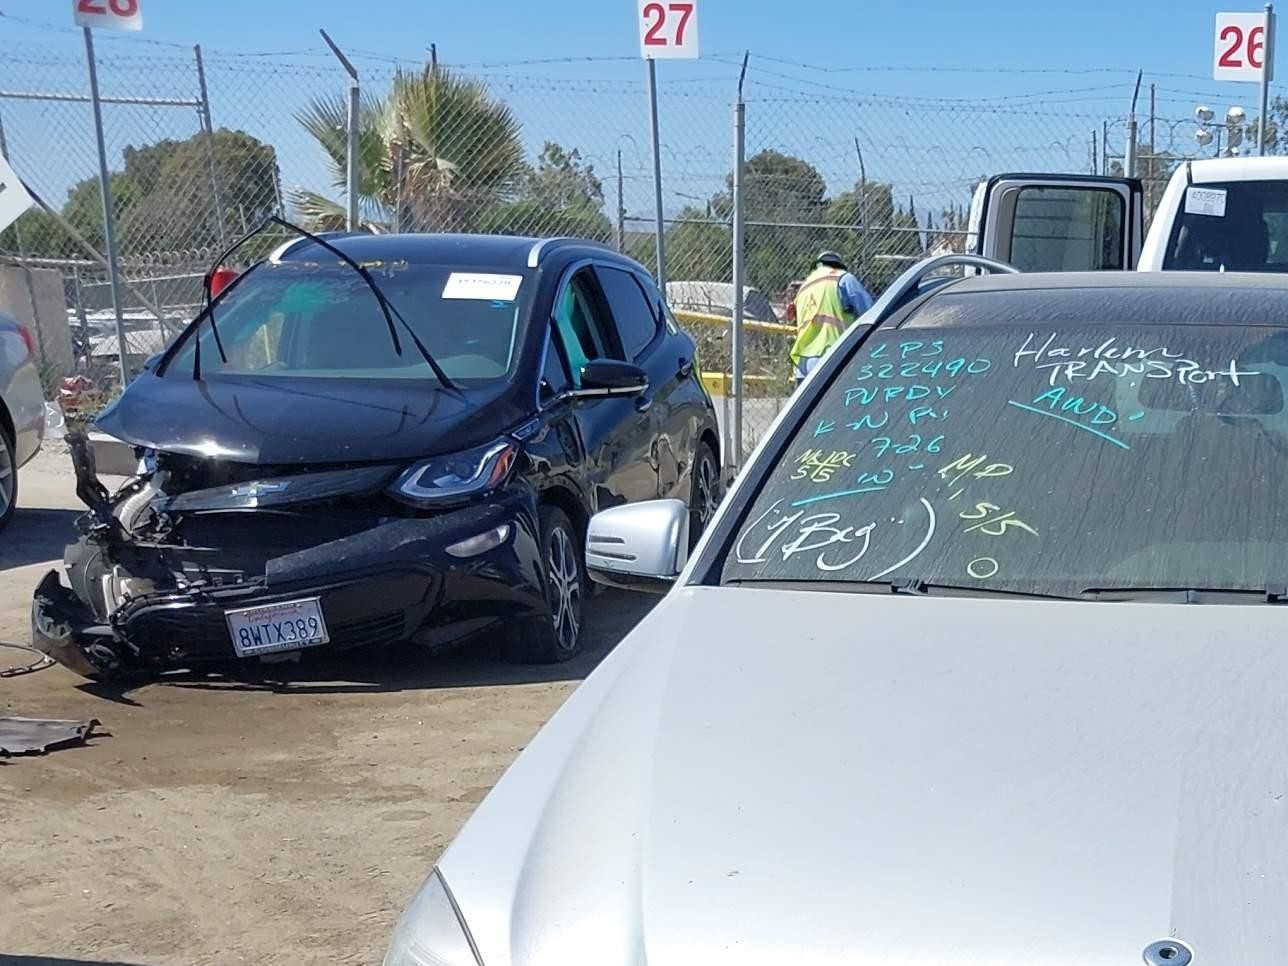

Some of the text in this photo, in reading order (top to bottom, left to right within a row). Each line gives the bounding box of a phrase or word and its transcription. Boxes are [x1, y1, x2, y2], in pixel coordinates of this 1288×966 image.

[643, 3, 693, 46] 27
[1219, 25, 1264, 69] 26
[1014, 332, 1183, 367] Harlem
[856, 357, 992, 381] 322490
[239, 616, 317, 648] 8WTX389
